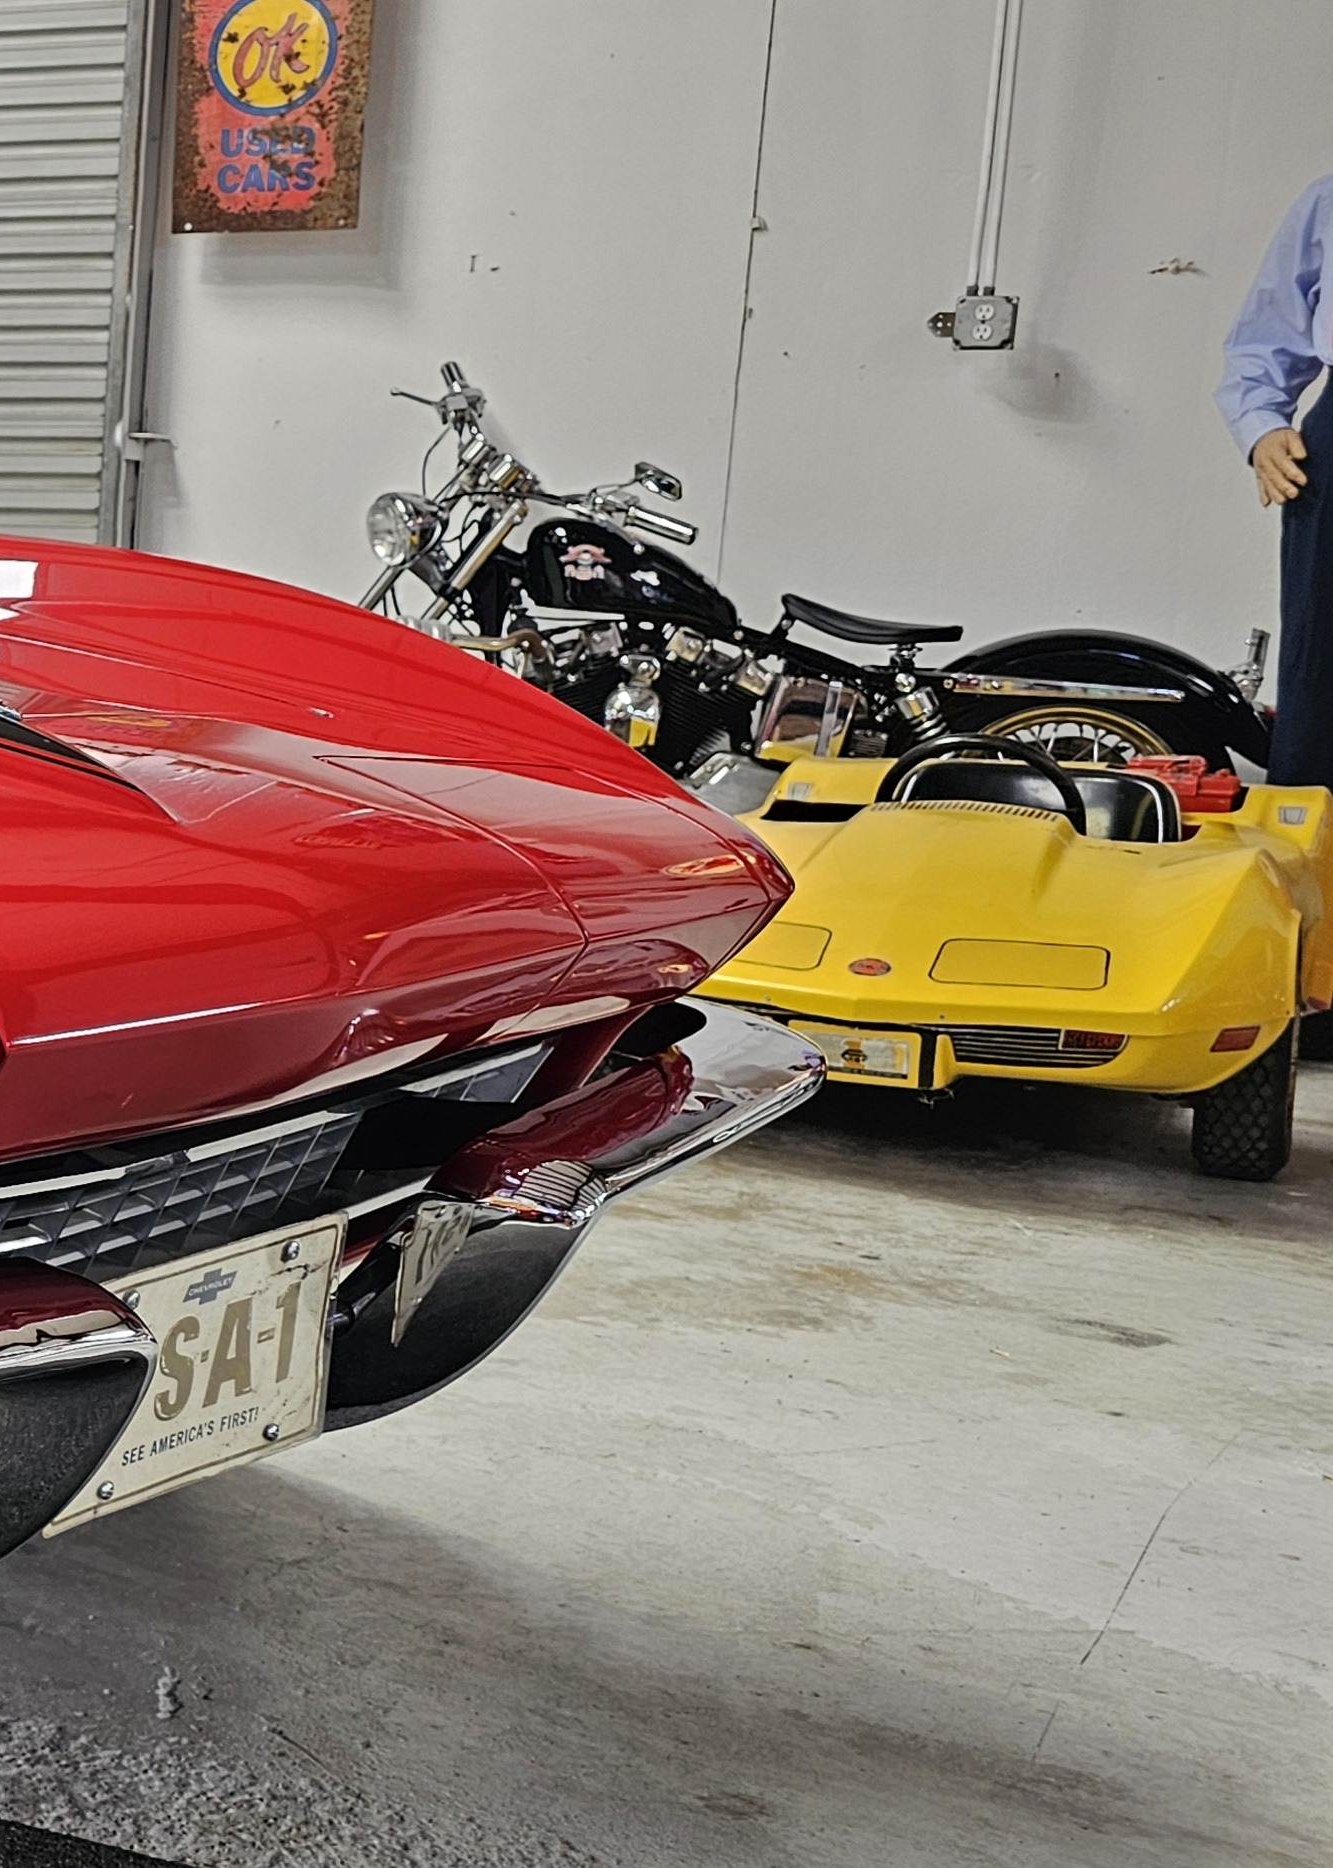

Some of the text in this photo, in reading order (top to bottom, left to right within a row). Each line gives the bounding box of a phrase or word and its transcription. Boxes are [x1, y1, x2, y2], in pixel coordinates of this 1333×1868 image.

[221, 126, 316, 158] USED
[217, 162, 317, 195] CARS
[188, 1277, 233, 1296] CHEVROLET
[122, 1406, 259, 1466] SEE AMERICA'S FIRST!
